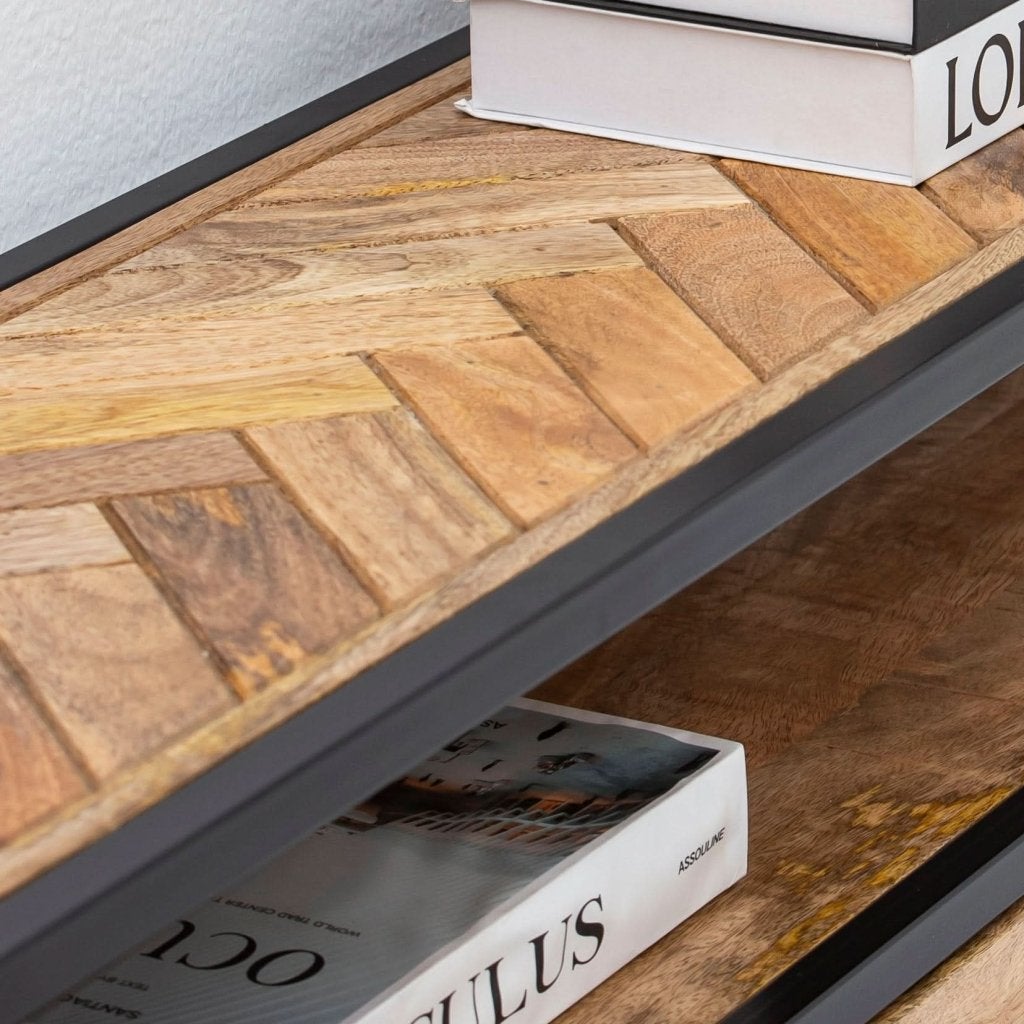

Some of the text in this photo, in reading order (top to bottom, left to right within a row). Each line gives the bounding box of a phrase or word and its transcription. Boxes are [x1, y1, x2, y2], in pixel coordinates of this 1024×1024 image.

[678, 827, 726, 875] ASSOULINE
[225, 899, 275, 915] CENTER
[313, 920, 361, 937] WORLD
[410, 893, 605, 1024] ULUS
